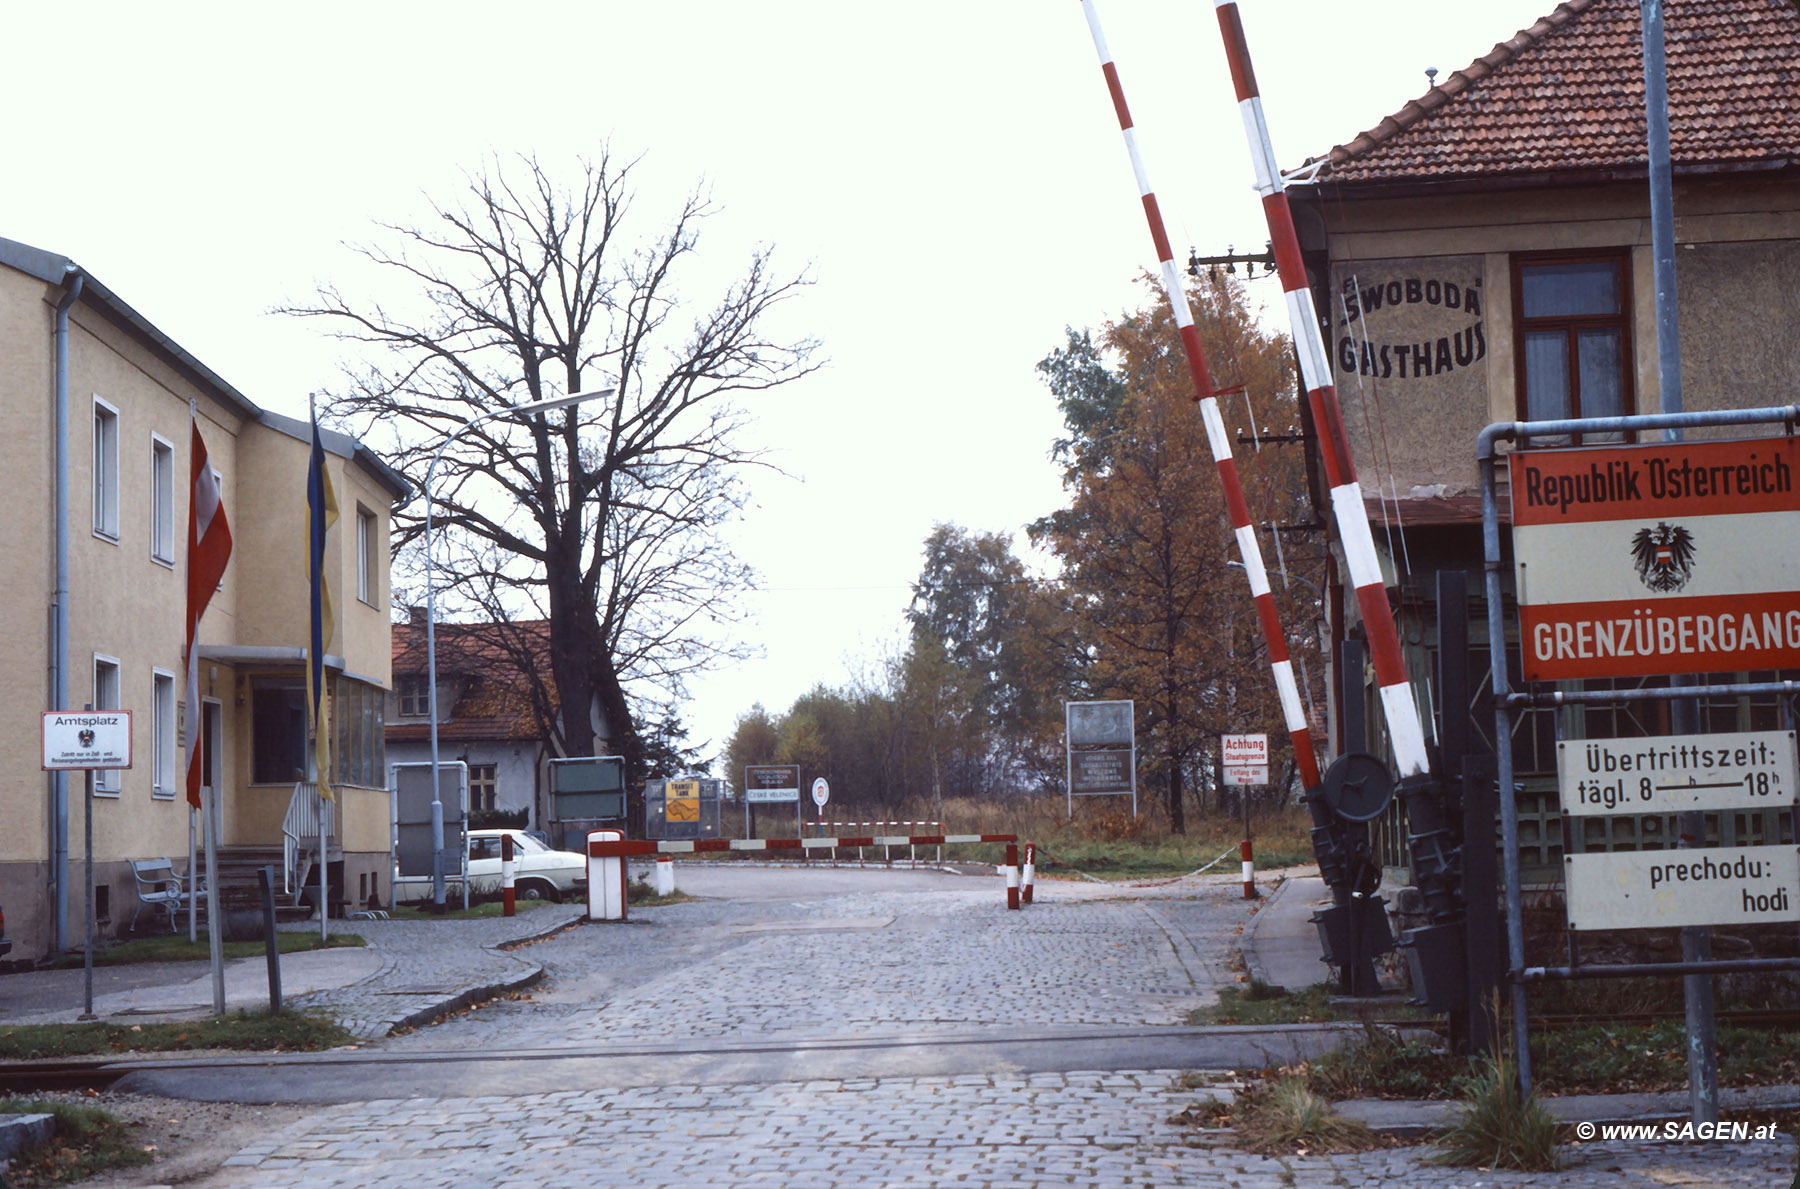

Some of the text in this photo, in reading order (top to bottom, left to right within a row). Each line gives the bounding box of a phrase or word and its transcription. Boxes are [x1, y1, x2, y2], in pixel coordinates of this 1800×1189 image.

[1341, 279, 1480, 326] SWOBODA
[1339, 321, 1486, 378] GASTHAUS
[1526, 453, 1791, 514] Republik Österreich
[1534, 609, 1800, 661] GRENZÜBERGANG
[55, 716, 118, 728] Amtsplatz
[1225, 738, 1264, 751] Achtung
[1225, 752, 1265, 761] Staatsgrenze
[1586, 741, 1776, 773] Übertrittszeit:
[1578, 779, 1630, 810] tägl.
[1650, 855, 1771, 889] prechodu:
[1743, 888, 1788, 912] hodi
